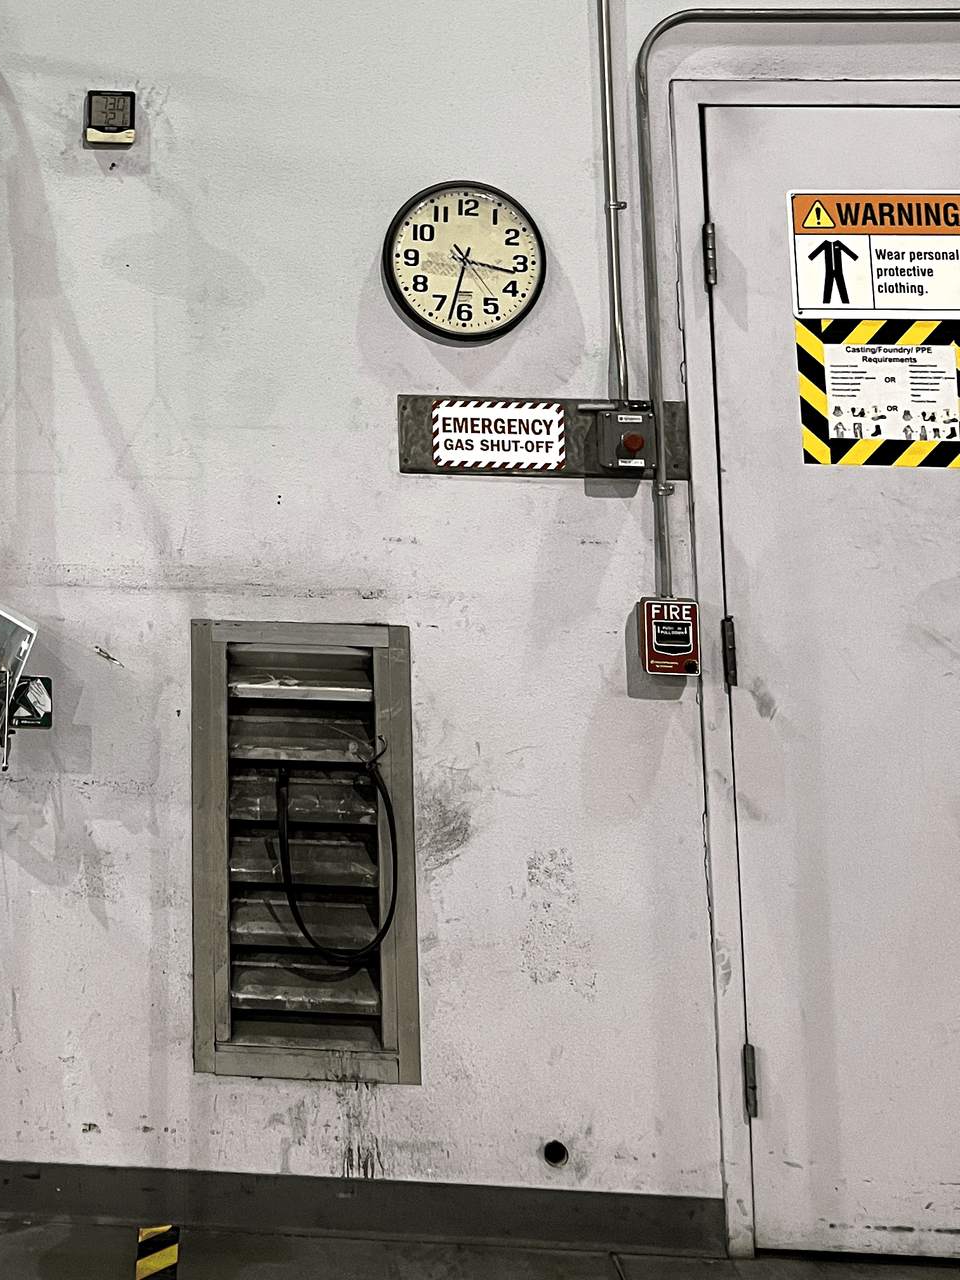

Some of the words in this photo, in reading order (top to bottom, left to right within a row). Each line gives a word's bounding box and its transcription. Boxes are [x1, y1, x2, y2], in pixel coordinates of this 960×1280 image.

[434, 206, 448, 222] 11
[458, 199, 479, 216] 12
[836, 202, 960, 227] WARNING
[493, 209, 498, 225] 1
[413, 224, 434, 241] 10
[505, 229, 520, 246] 2
[404, 249, 419, 266] 9
[513, 255, 528, 272] 3
[875, 249, 905, 261] Wear
[909, 248, 959, 262] personal
[876, 266, 934, 279] protective
[412, 275, 428, 292] 8
[502, 280, 519, 297] 4
[877, 282, 929, 296] clothing.
[432, 294, 447, 311] 7
[483, 297, 499, 315] 5
[457, 304, 473, 321] 6
[861, 355, 917, 364] Requirements
[442, 417, 554, 436] EMERGENCY
[443, 438, 474, 451] GAS
[480, 439, 554, 453] SHUT-OFF
[651, 604, 692, 620] FIRE
